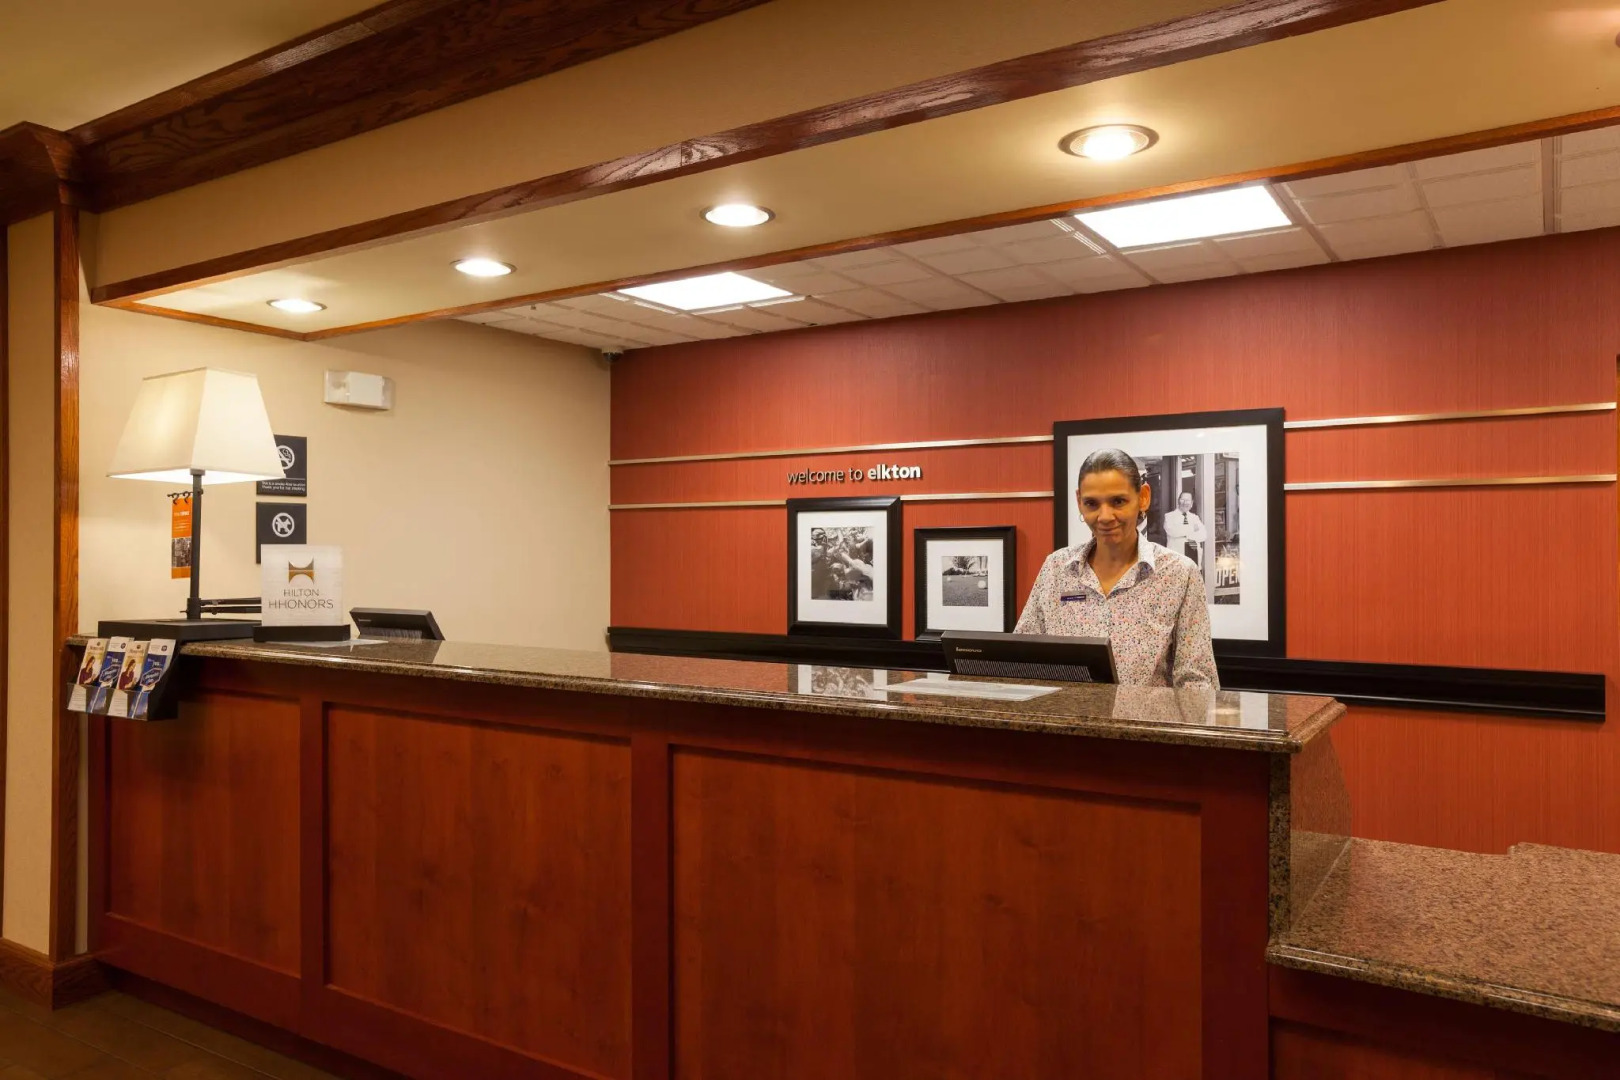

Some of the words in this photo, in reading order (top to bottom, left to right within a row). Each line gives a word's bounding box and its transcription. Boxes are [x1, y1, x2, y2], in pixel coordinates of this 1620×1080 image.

[787, 468, 844, 485] welcome
[848, 468, 864, 482] to
[867, 463, 921, 481] elkton
[284, 589, 320, 597] HILTON
[268, 599, 334, 609] HHONORS
